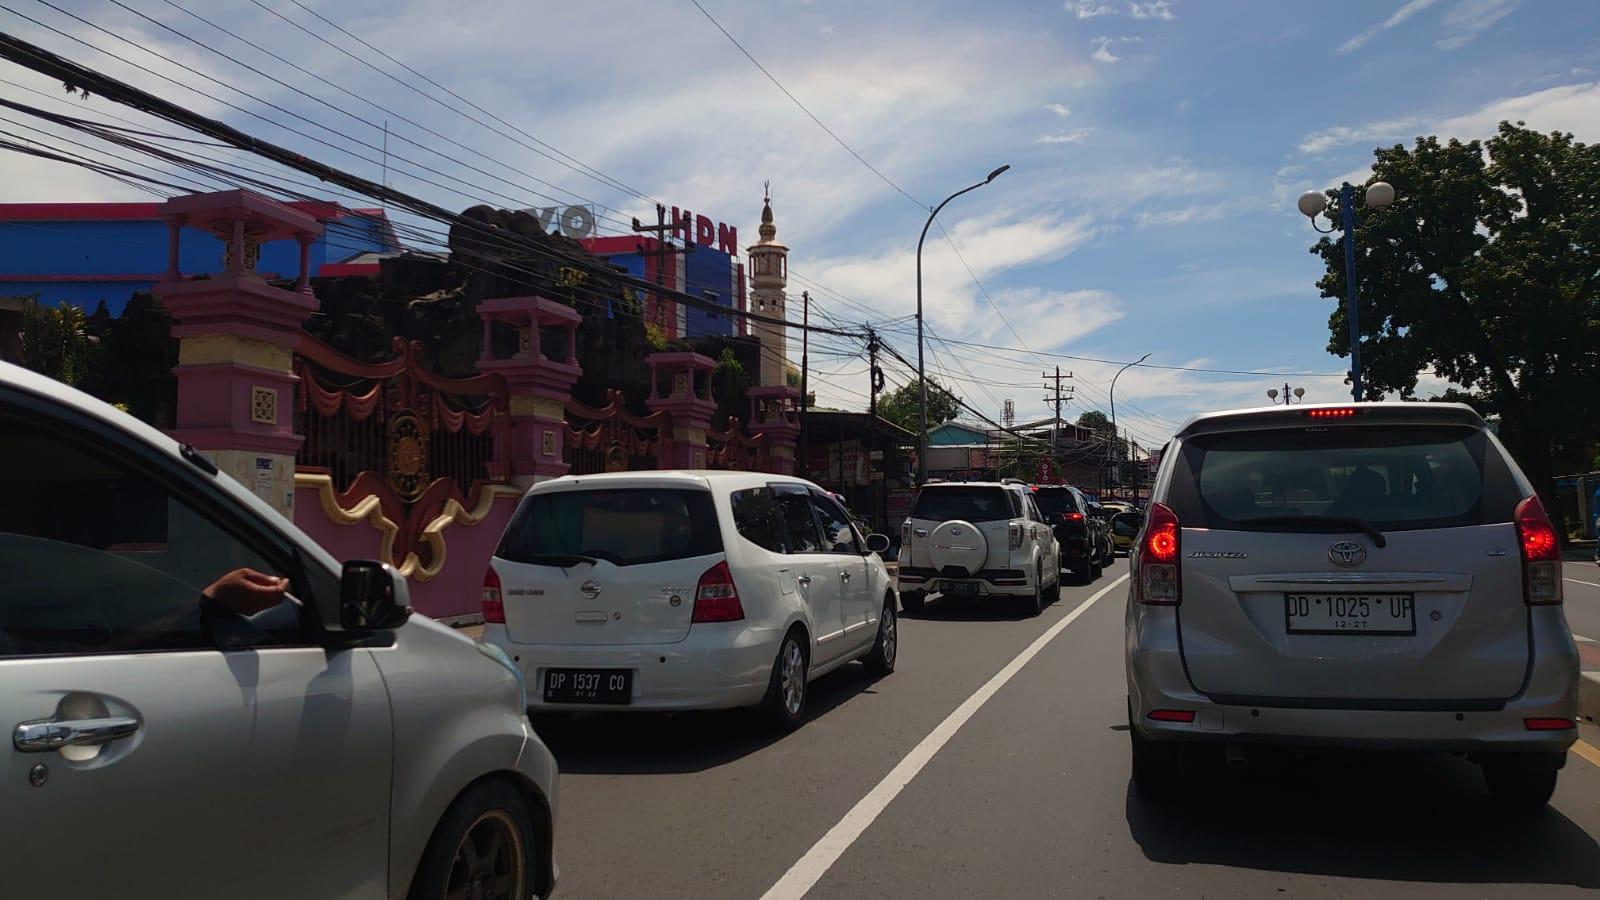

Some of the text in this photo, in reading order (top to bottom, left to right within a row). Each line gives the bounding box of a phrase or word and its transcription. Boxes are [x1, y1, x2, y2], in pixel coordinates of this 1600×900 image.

[672, 206, 737, 257] HDN
[1288, 597, 1310, 617] DD
[1326, 596, 1370, 618] 1025
[550, 672, 566, 689] DP
[573, 672, 600, 691] 1537
